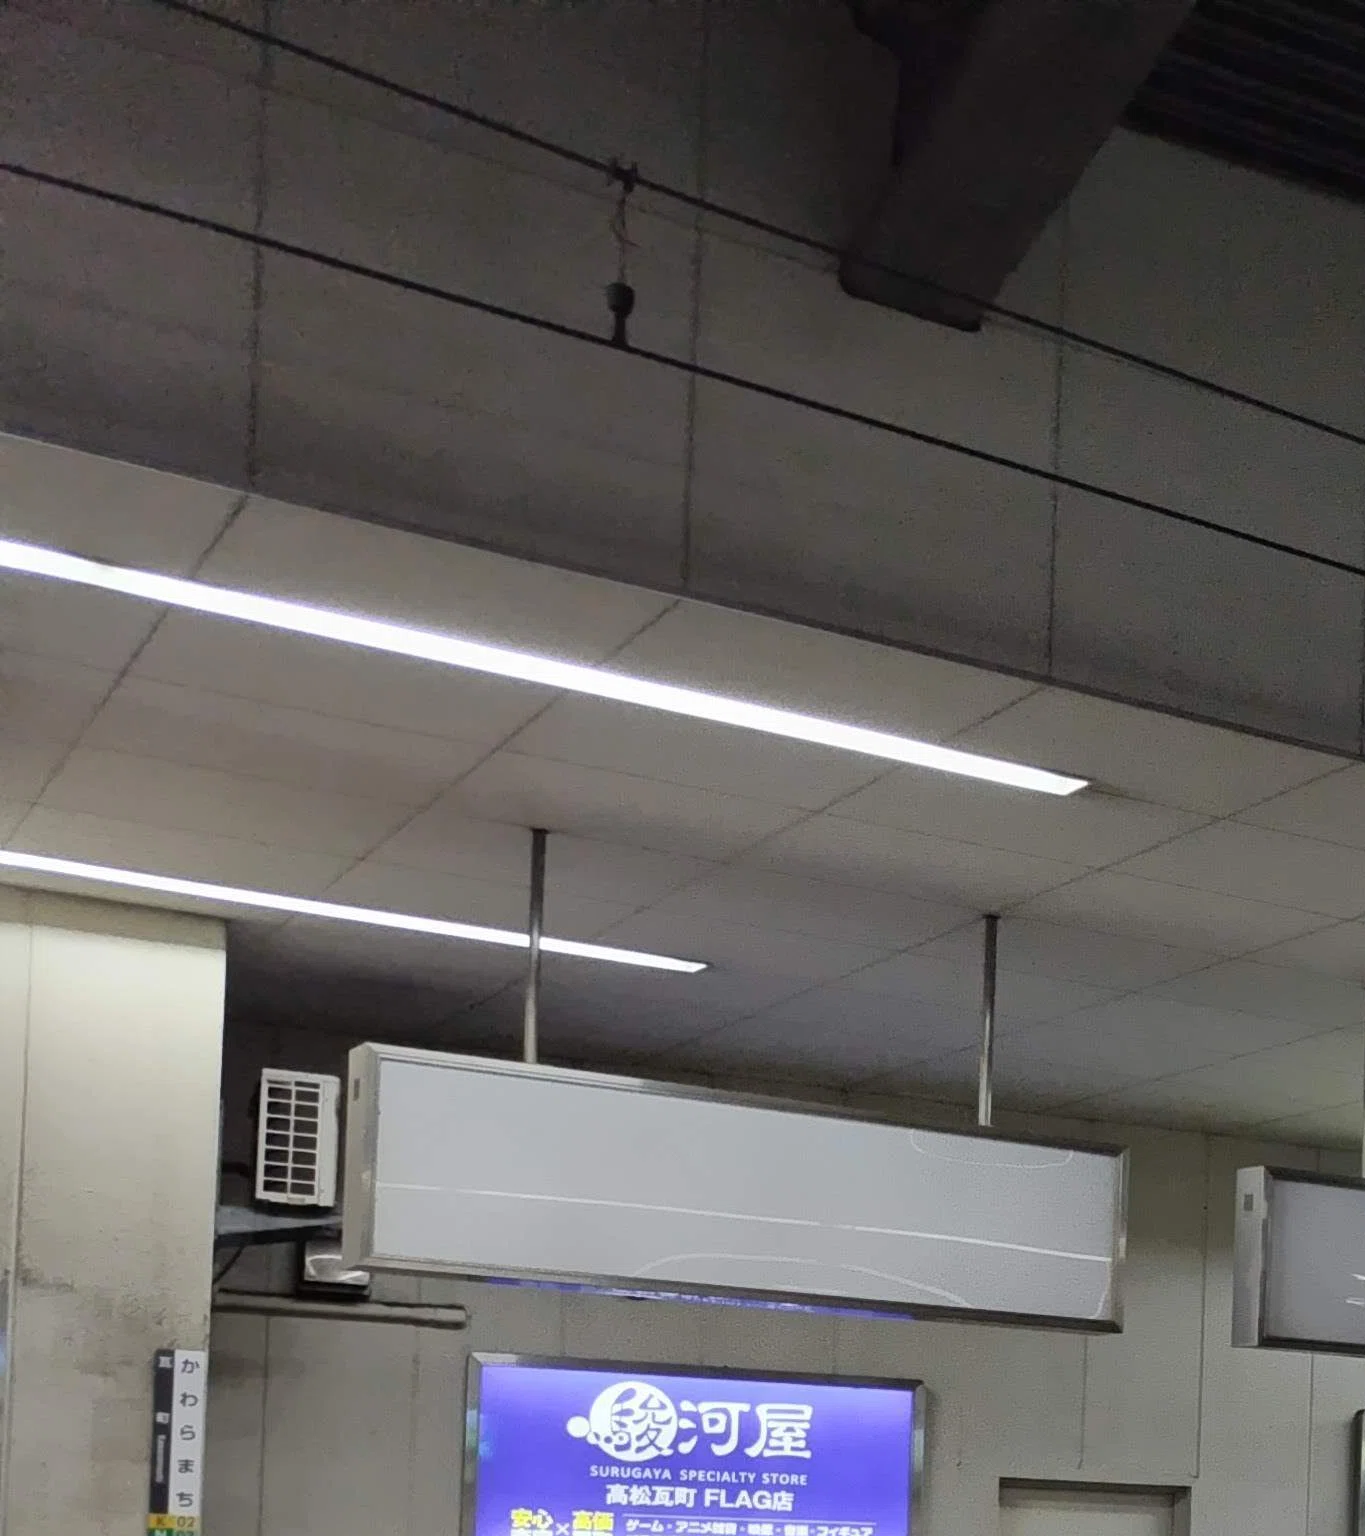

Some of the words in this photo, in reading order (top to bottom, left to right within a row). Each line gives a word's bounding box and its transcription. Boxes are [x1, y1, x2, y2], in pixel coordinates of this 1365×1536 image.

[176, 1358, 200, 1508] かわらまち
[589, 1384, 814, 1461] 駿河屋
[590, 1464, 672, 1481] SURUGAYA
[679, 1469, 756, 1485] SPECIALTY
[761, 1472, 808, 1486] STORE
[605, 1483, 697, 1509] 高松瓦町
[704, 1489, 794, 1512] FLAG店
[176, 1516, 196, 1528] 02
